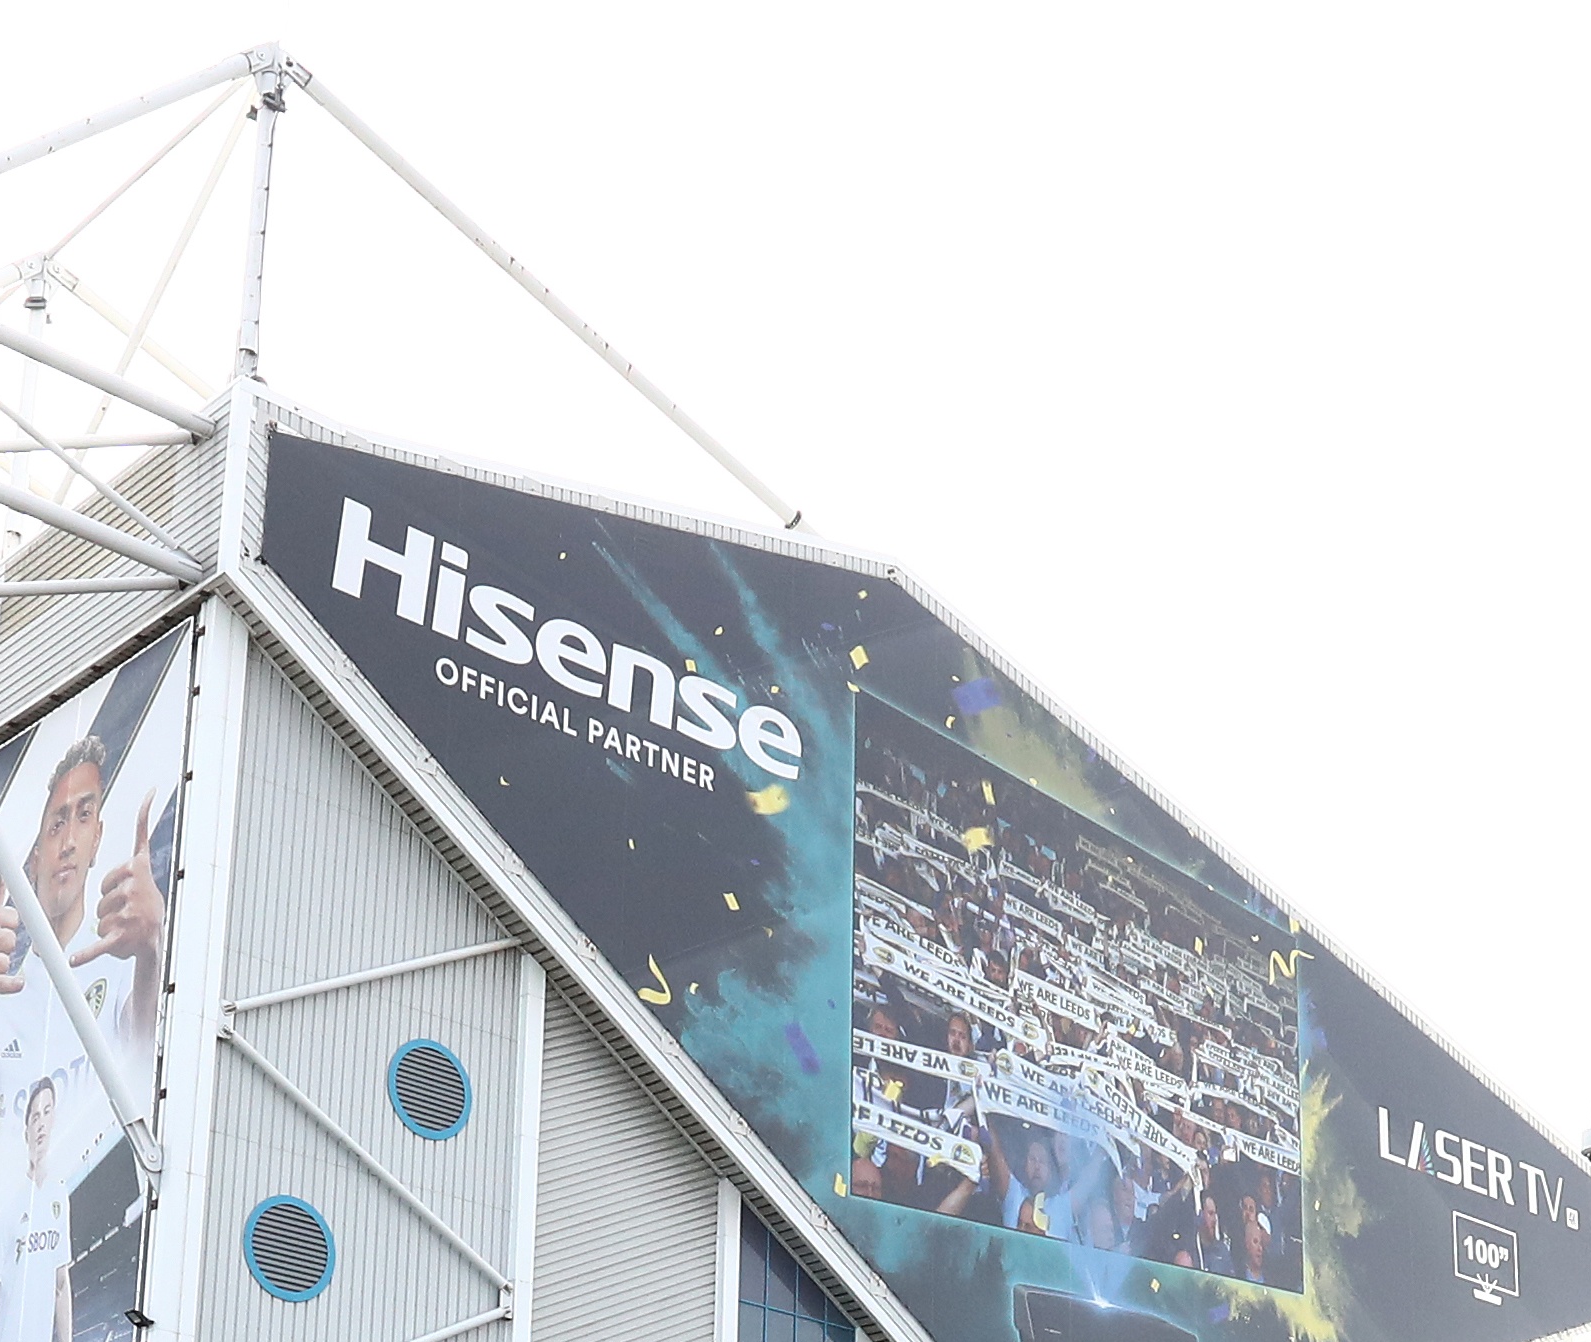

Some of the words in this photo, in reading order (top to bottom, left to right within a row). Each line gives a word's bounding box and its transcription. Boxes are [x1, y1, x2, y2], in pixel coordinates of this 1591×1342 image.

[332, 496, 803, 780] Hisense
[435, 657, 578, 740] OFFICIAL
[587, 717, 716, 793] PARTNER
[902, 958, 930, 983] WE
[934, 978, 966, 1002] ARE
[969, 995, 1016, 1028] LEEDS
[1017, 976, 1034, 998] WE
[1036, 987, 1058, 1005] ARE
[1060, 998, 1092, 1021] LEEDS
[1020, 1063, 1046, 1087] WE
[1117, 1054, 1132, 1070] WE
[1134, 1061, 1153, 1078] ARE
[1154, 1068, 1183, 1089] LEEDS
[874, 1110, 943, 1152] LEEDS
[984, 1081, 1012, 1105] WE
[1016, 1094, 1049, 1116] ARE
[1053, 1107, 1100, 1136] LEEDS
[1242, 1139, 1257, 1155] WE
[1257, 1144, 1276, 1163] ARE
[1378, 1106, 1516, 1207] LASER
[1519, 1161, 1564, 1223] TV
